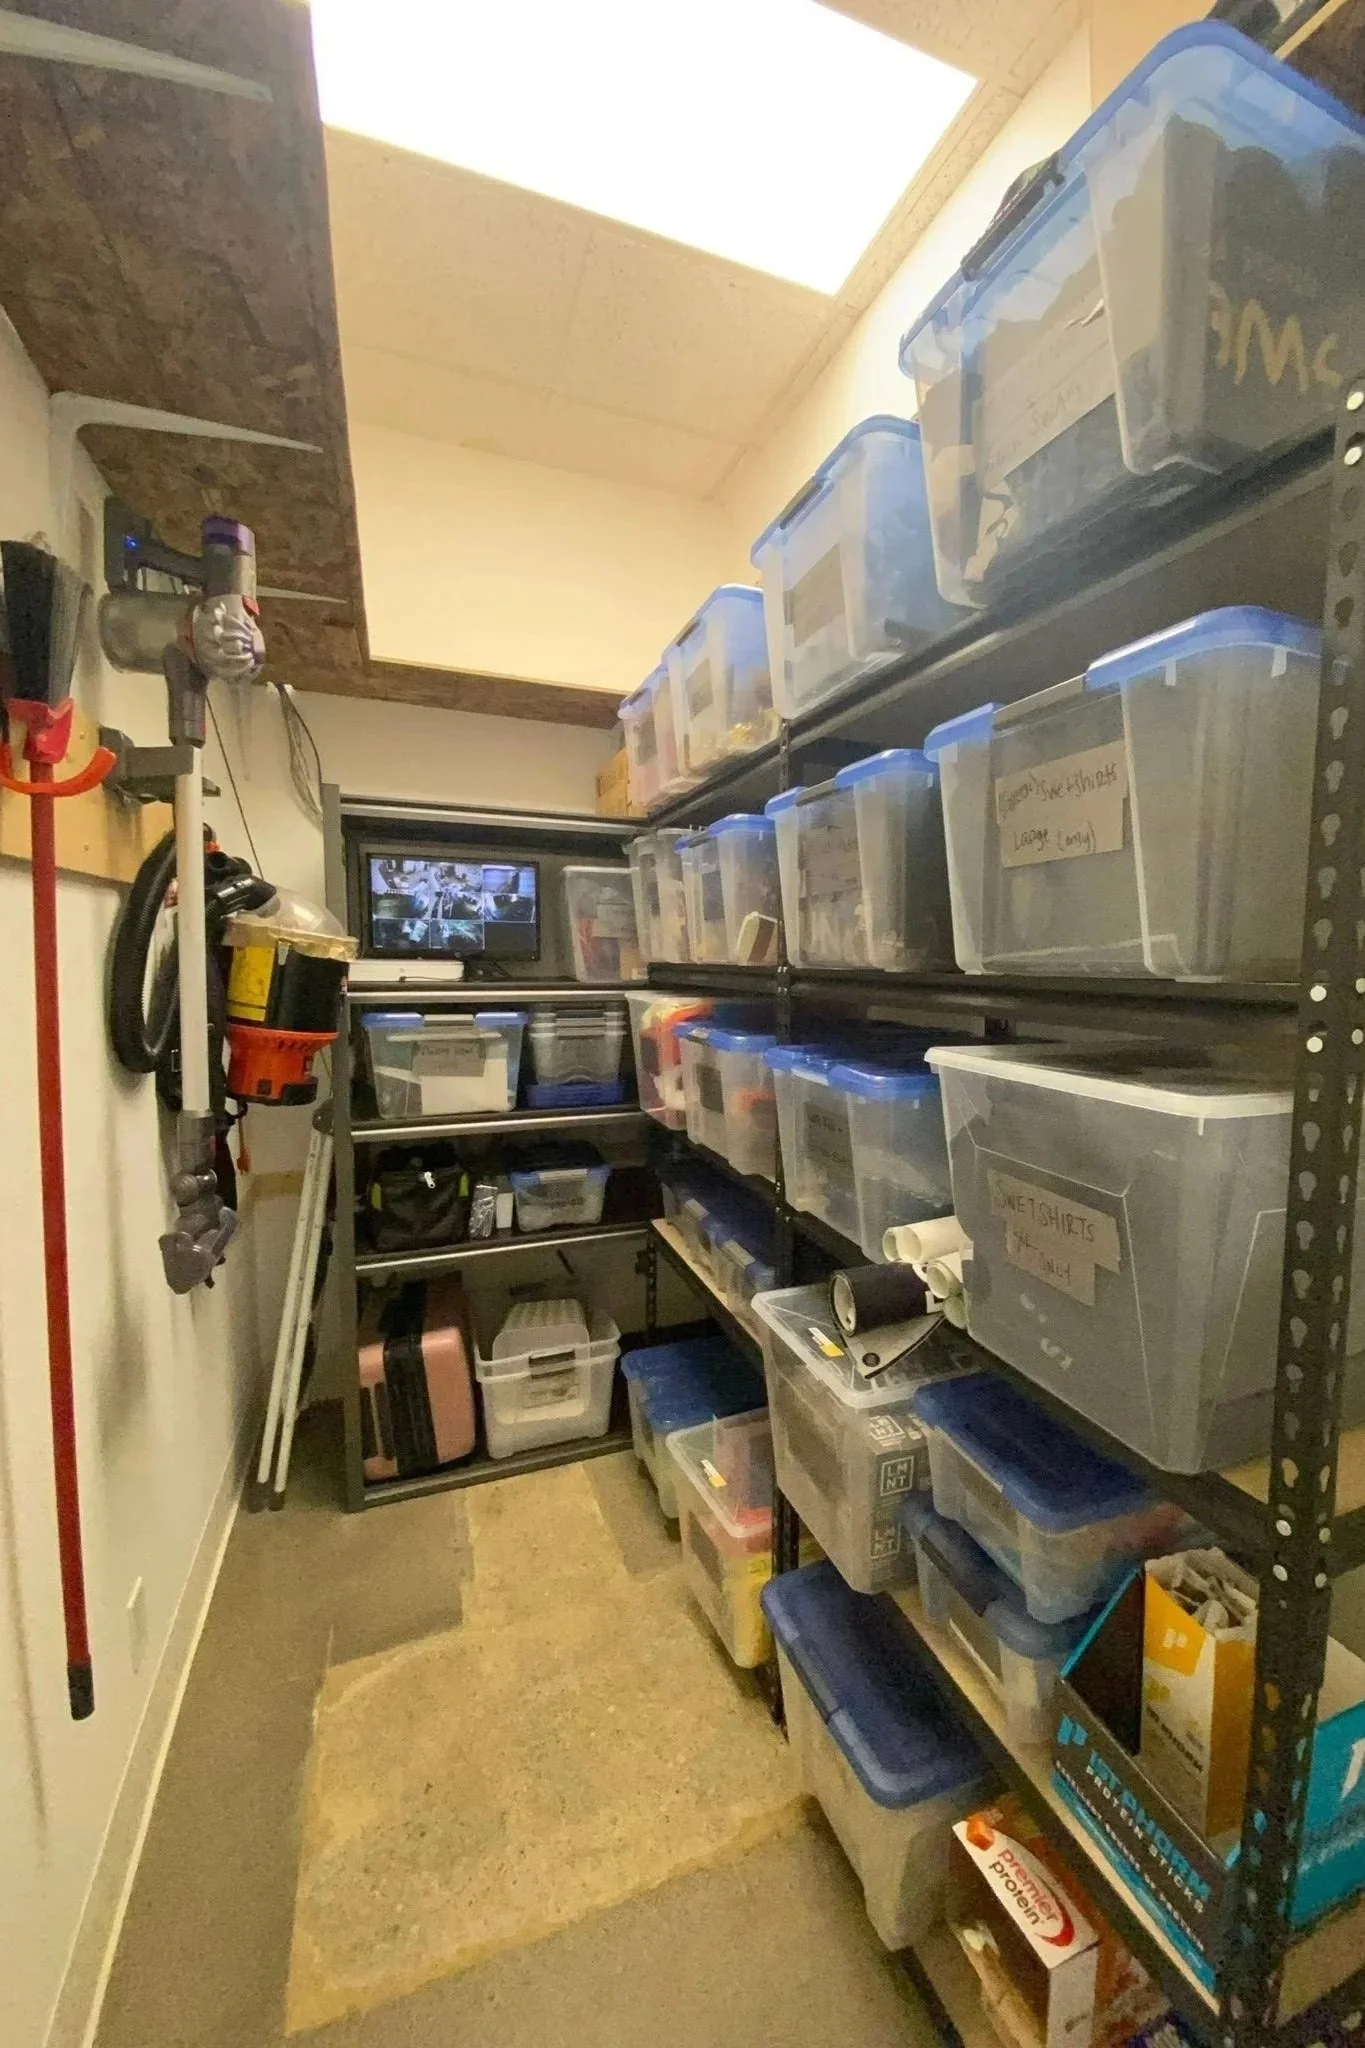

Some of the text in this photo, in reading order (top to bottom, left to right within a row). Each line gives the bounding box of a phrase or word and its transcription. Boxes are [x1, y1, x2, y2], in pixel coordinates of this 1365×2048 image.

[886, 1475, 907, 1490] NT
[1086, 1765, 1204, 1914] PROTEIN STICKS
[987, 1861, 1043, 1926] protein
[997, 1848, 1059, 1922] premier
